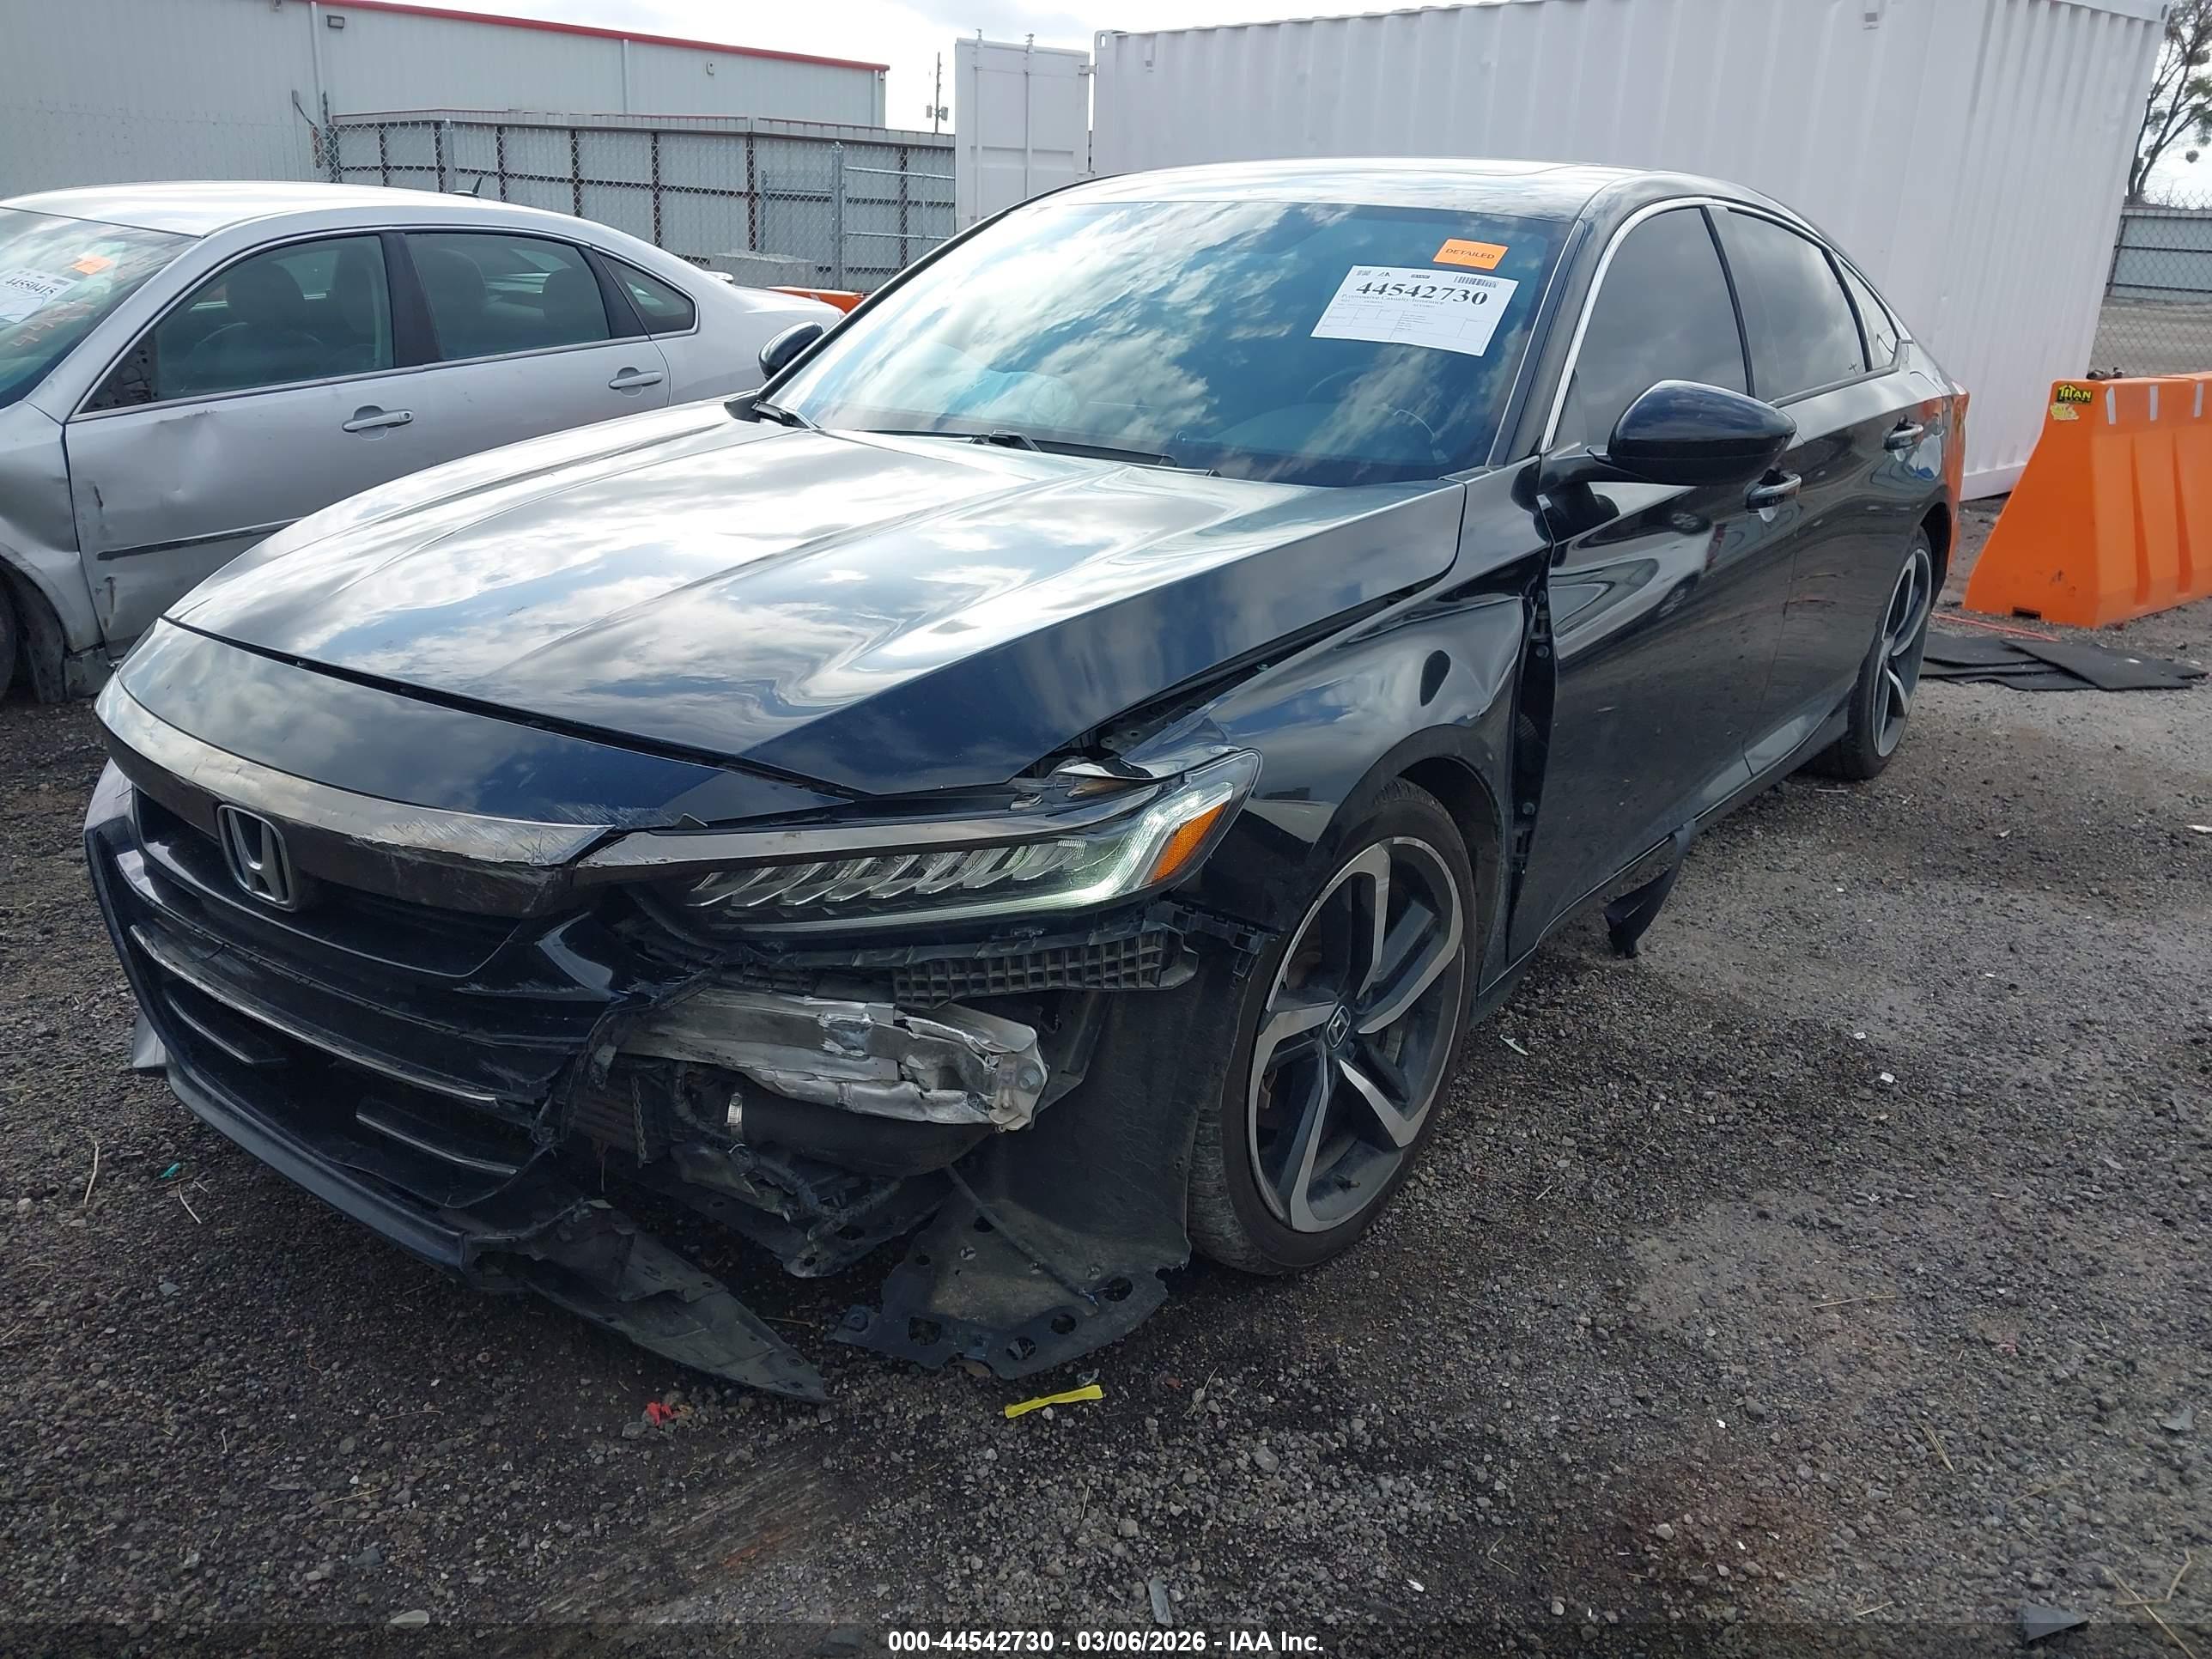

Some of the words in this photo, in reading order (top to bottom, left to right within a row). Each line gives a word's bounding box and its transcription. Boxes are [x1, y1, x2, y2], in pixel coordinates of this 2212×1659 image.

[1445, 248, 1495, 259] DETAILED
[5, 277, 58, 295] 44550415
[1356, 281, 1489, 306] 44542730
